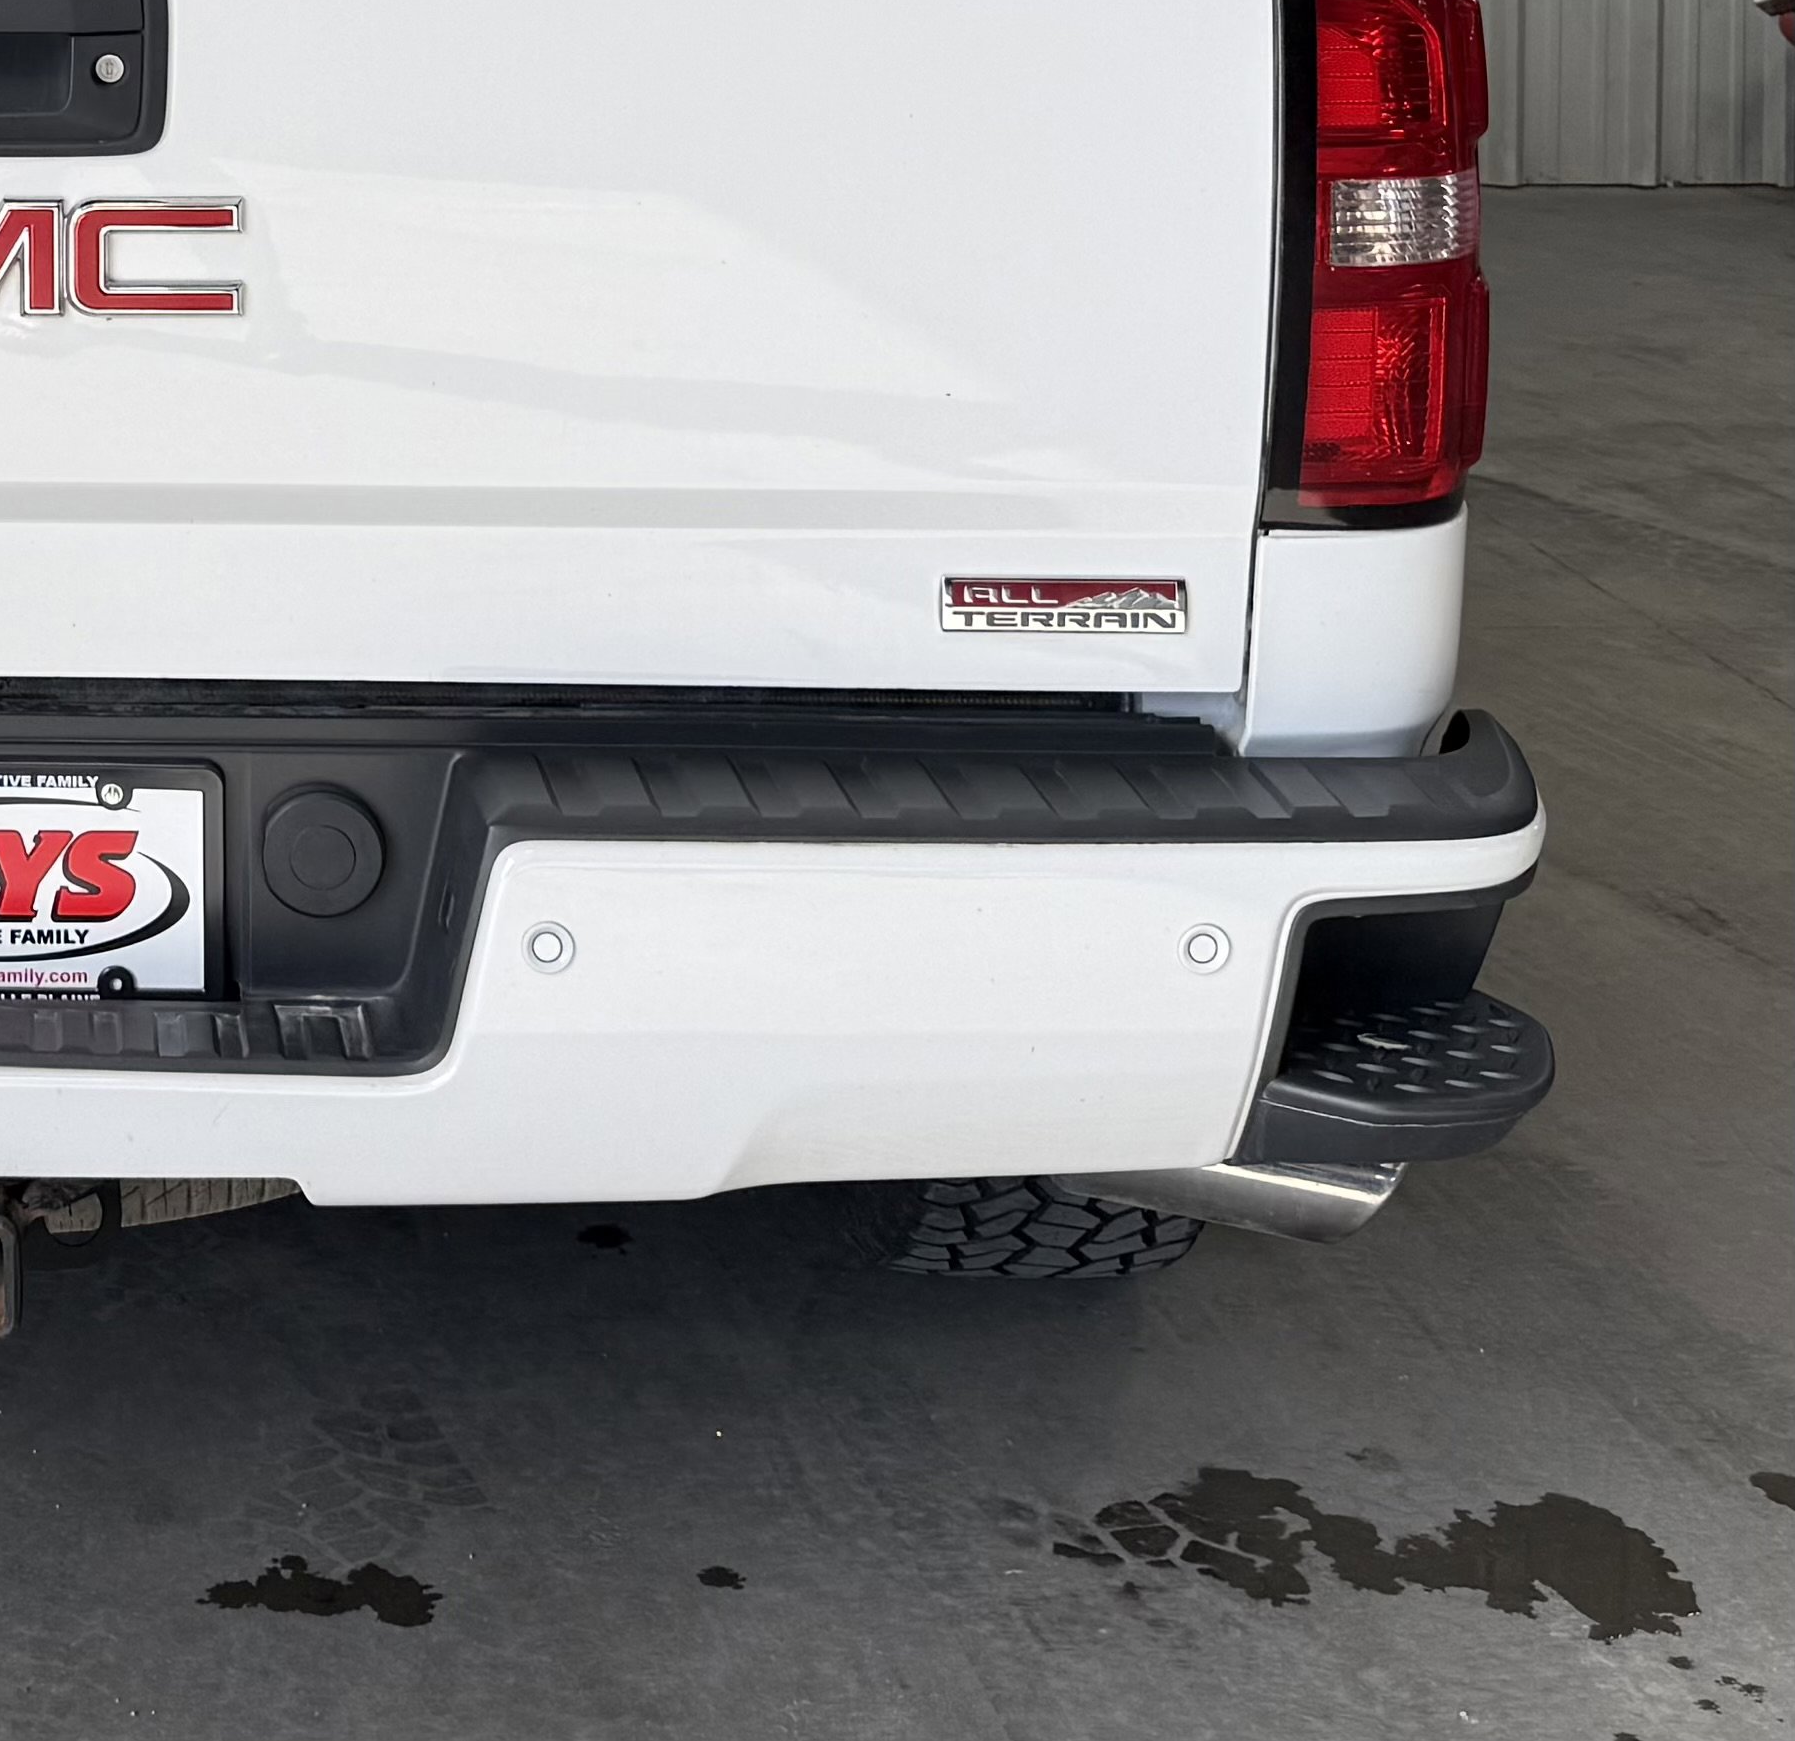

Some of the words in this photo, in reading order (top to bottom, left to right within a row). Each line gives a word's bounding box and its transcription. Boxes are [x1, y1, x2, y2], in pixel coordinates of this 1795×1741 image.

[962, 584, 1059, 604] ALL
[952, 610, 1177, 629] TERRAIN
[35, 774, 100, 789] FAMILY
[8, 928, 90, 946] FAMILY
